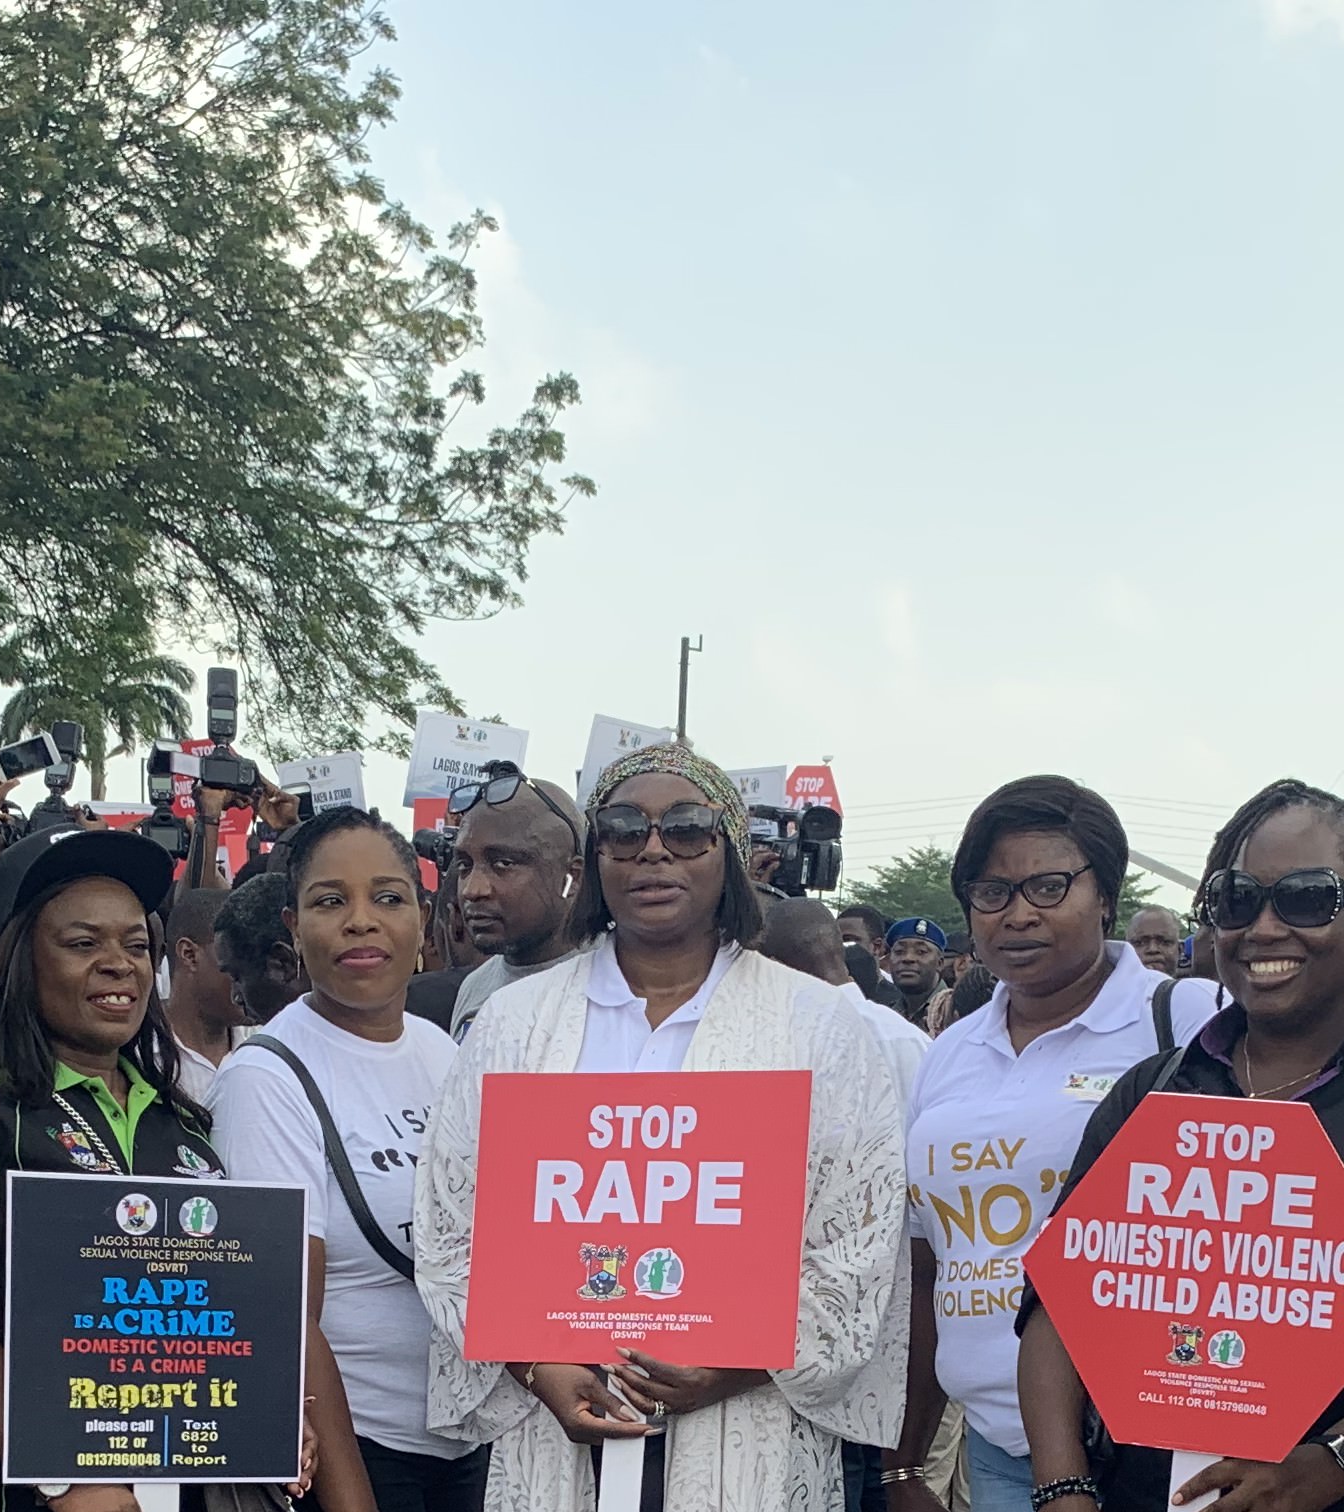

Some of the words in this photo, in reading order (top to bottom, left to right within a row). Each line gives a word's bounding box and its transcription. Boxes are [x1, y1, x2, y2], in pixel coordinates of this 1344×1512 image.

[433, 757, 460, 774] LAGOS
[795, 777, 824, 792] STOP
[588, 1104, 698, 1149] STOP
[1176, 1120, 1275, 1162] STOP
[928, 1144, 934, 1176] I
[951, 1137, 1027, 1172] SAY
[533, 1159, 744, 1225] RAPE
[1126, 1162, 1317, 1229] RAPE
[94, 1235, 129, 1247] LAGOS
[132, 1236, 159, 1248] STATE
[163, 1238, 214, 1250] DOMESTIC
[217, 1239, 240, 1250] AND
[1064, 1217, 1213, 1272] DOMESTIC
[80, 1248, 117, 1259] SEXUAL
[120, 1249, 171, 1260] VIOLENCE
[173, 1251, 224, 1262] RESPONSE
[226, 1252, 253, 1263] TEAM
[146, 1262, 188, 1275] (DSVRT)
[102, 1277, 209, 1306] RAPE
[934, 1285, 1024, 1318] VIOLENC
[1092, 1270, 1199, 1315] CHILD
[1208, 1281, 1335, 1329] ABUSE
[74, 1314, 94, 1329] IS
[98, 1315, 113, 1329] A
[547, 1312, 578, 1320] LAGOS
[579, 1312, 605, 1320] STATE
[608, 1312, 653, 1321] DOMESTIC
[656, 1314, 676, 1322] AND
[678, 1314, 713, 1323] SEXUAL
[569, 1321, 613, 1329] VIOLENCE
[616, 1322, 662, 1330] RESPONSE
[664, 1323, 689, 1331] TEAM
[611, 1331, 646, 1341] (DSVRT)
[62, 1338, 157, 1354] DOMESTIC
[162, 1340, 252, 1357] VIOLENCE
[110, 1359, 125, 1372] IS
[132, 1359, 146, 1372] A
[151, 1359, 206, 1374] CRIME
[1160, 1378, 1192, 1387] VIOLENCE
[1194, 1381, 1228, 1391] RESPONSE
[1230, 1385, 1248, 1393] TEAM
[1168, 1372, 1186, 1380] STATE
[1188, 1374, 1222, 1384] DOMESTIC
[1222, 1378, 1239, 1386] AND
[69, 1377, 197, 1414] Report
[209, 1378, 238, 1408] it
[1138, 1392, 1165, 1403] CALL
[1168, 1395, 1184, 1406] 112
[1186, 1398, 1202, 1408] OR
[1204, 1399, 1267, 1415] 08137960048
[85, 1419, 128, 1434] please
[130, 1419, 154, 1433] call
[184, 1419, 217, 1431] Text
[108, 1436, 128, 1449] 112
[134, 1437, 147, 1448] or
[181, 1431, 218, 1442] 6820
[192, 1443, 207, 1453] to
[77, 1452, 161, 1467] 08137960048
[172, 1454, 227, 1467] Report
